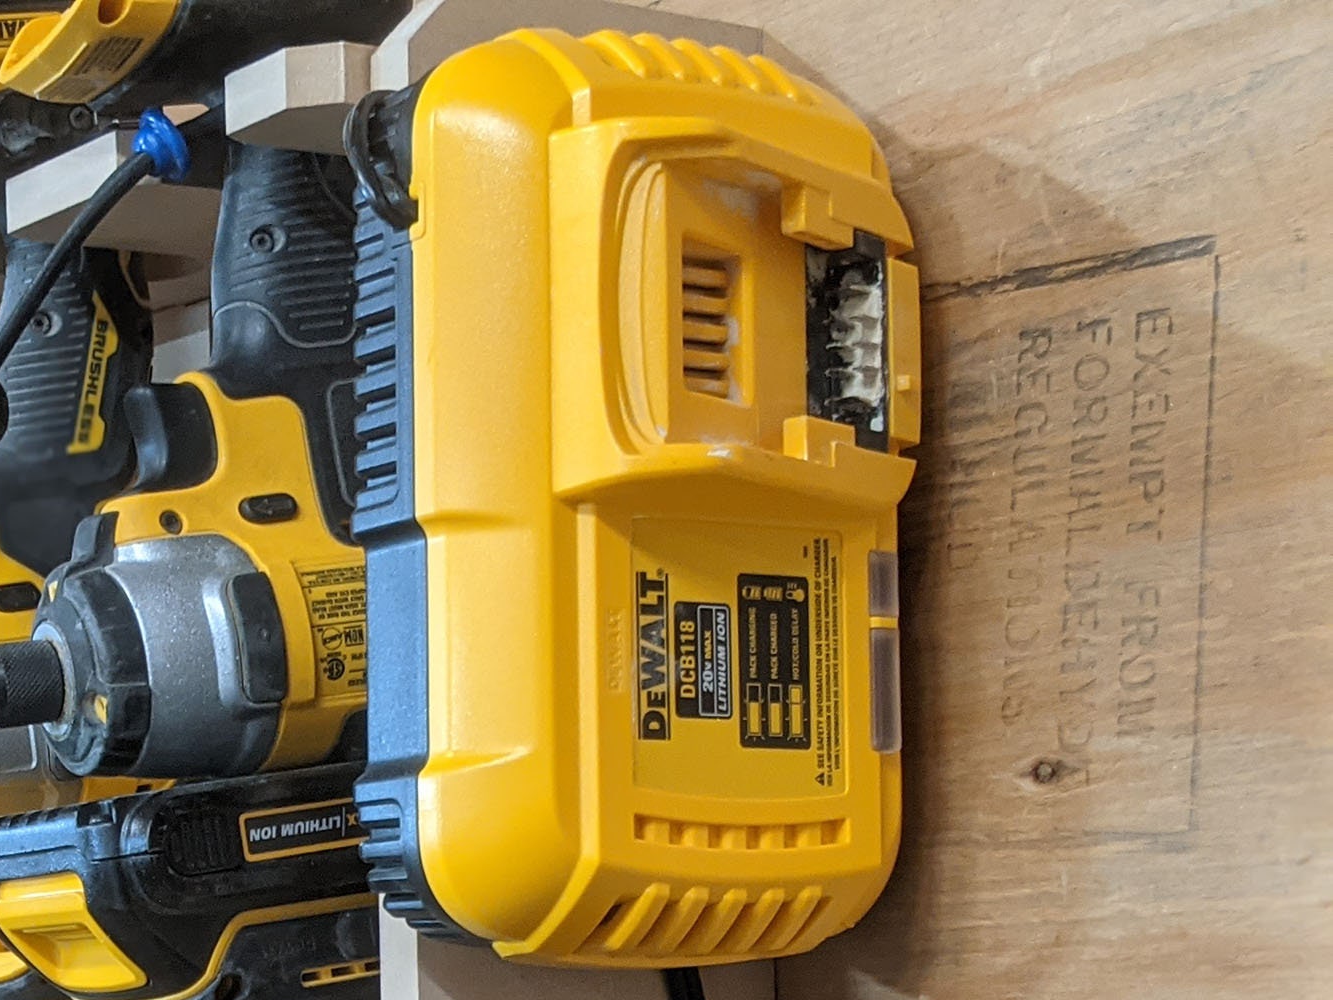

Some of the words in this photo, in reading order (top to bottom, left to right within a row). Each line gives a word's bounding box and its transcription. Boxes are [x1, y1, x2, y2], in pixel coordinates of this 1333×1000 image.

[78, 319, 109, 444] BRUSHLESS
[1126, 307, 1174, 541] EXEMPT
[639, 571, 667, 740] DEWALT
[679, 620, 696, 698] DCB118
[704, 630, 714, 660] MAX
[716, 612, 726, 642] ION
[1115, 580, 1161, 738] FROM
[717, 645, 727, 712] LITHIUM
[770, 656, 778, 679] PACK
[249, 827, 277, 842] ION
[281, 815, 341, 837] LITHIUM
